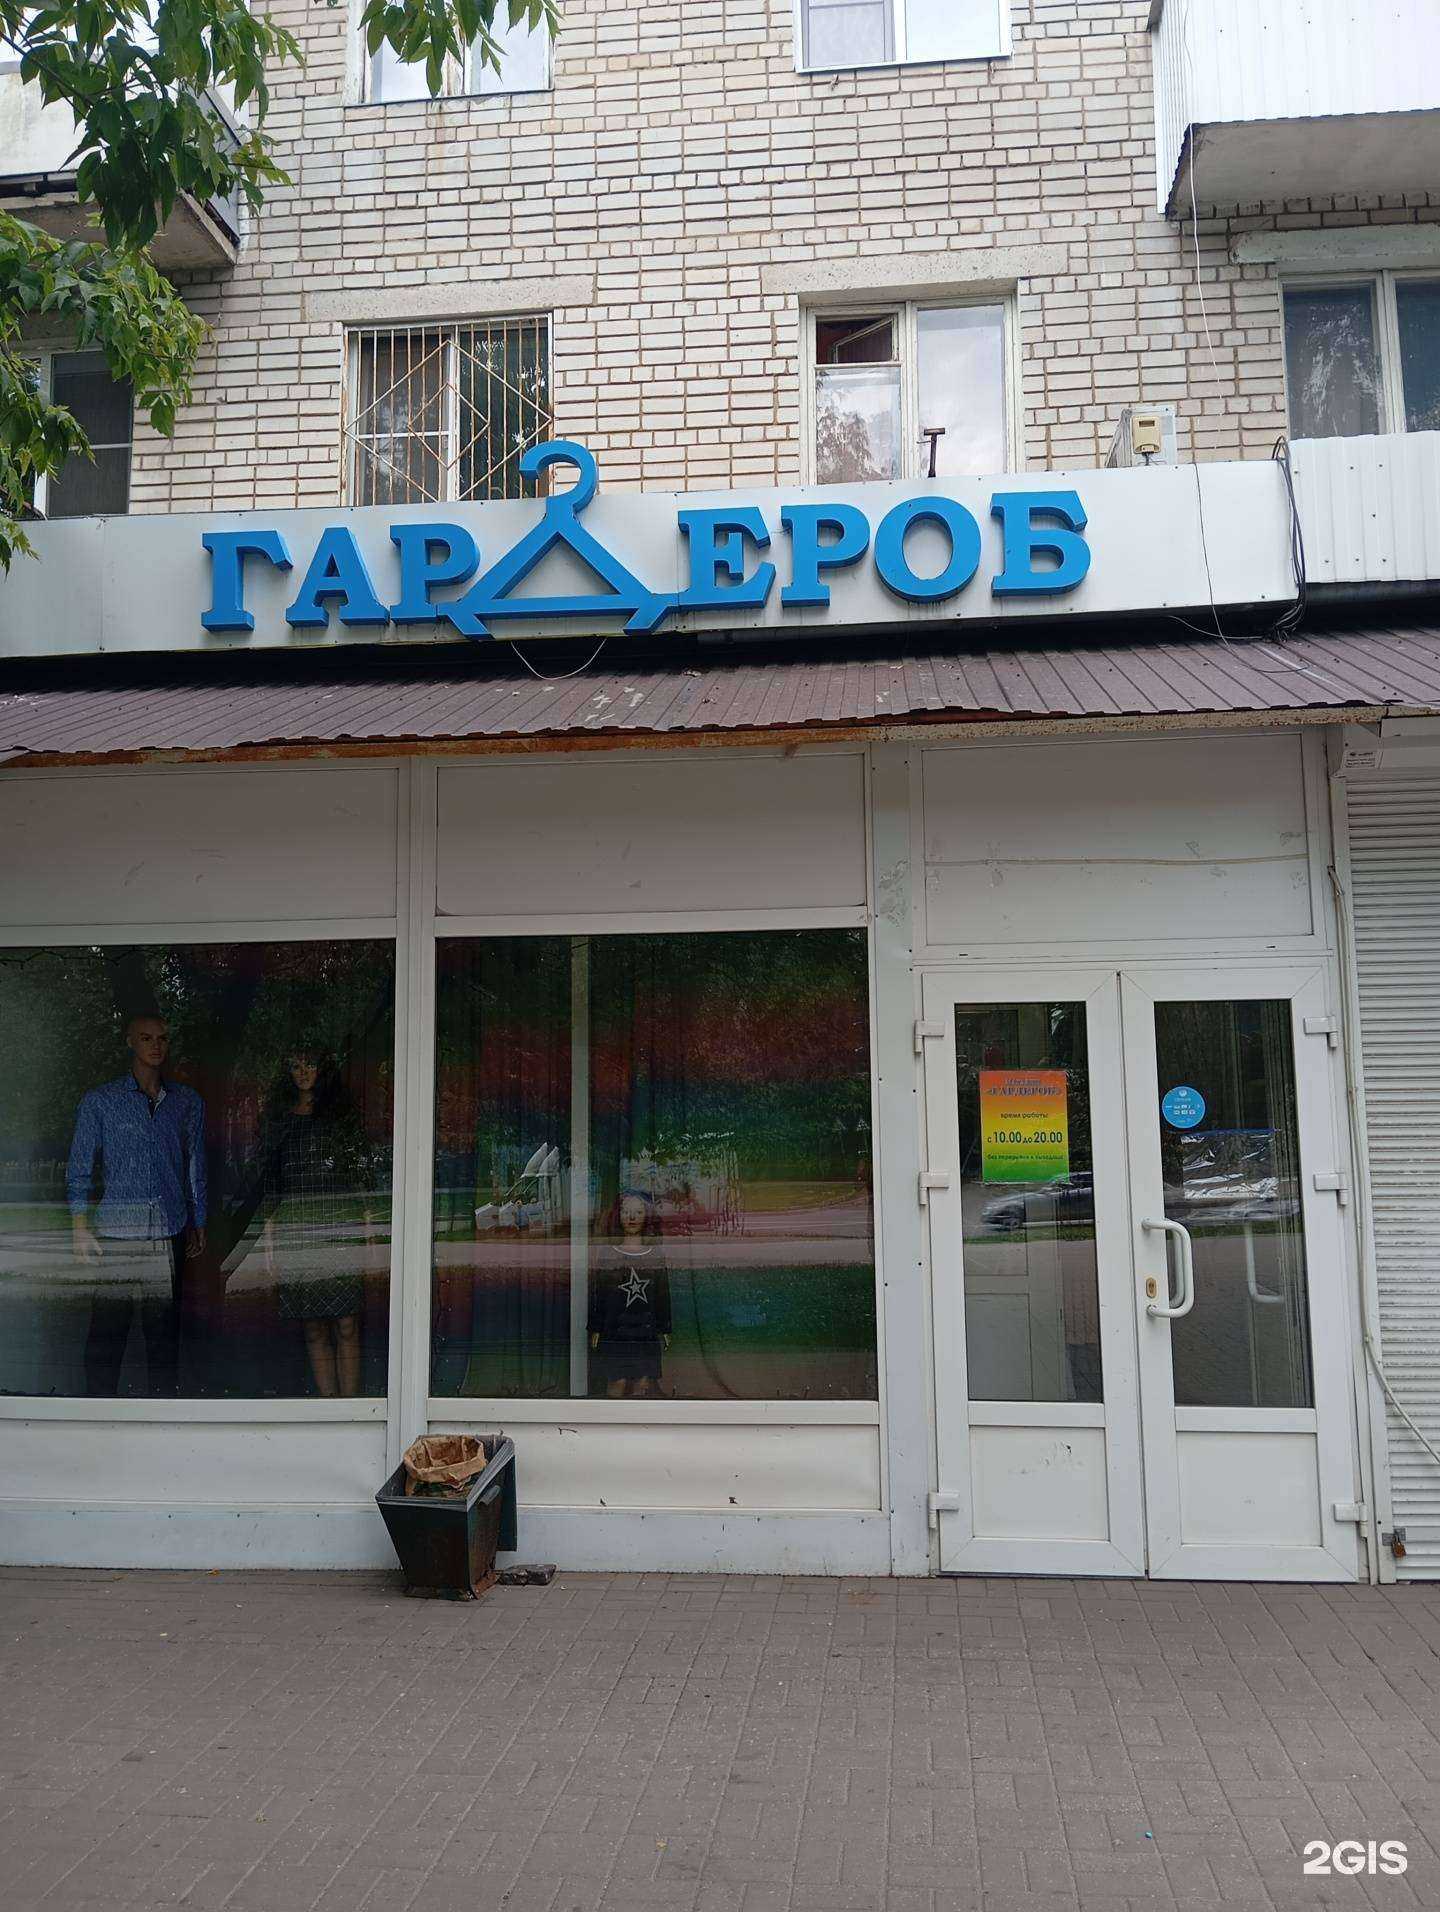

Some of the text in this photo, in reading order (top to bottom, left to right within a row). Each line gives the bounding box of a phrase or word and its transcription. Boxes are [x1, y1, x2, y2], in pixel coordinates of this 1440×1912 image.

[200, 440, 1091, 639] ГАРДЕРОБ
[994, 1131, 1022, 1143] 10.00
[1034, 1131, 1063, 1143] 20.00
